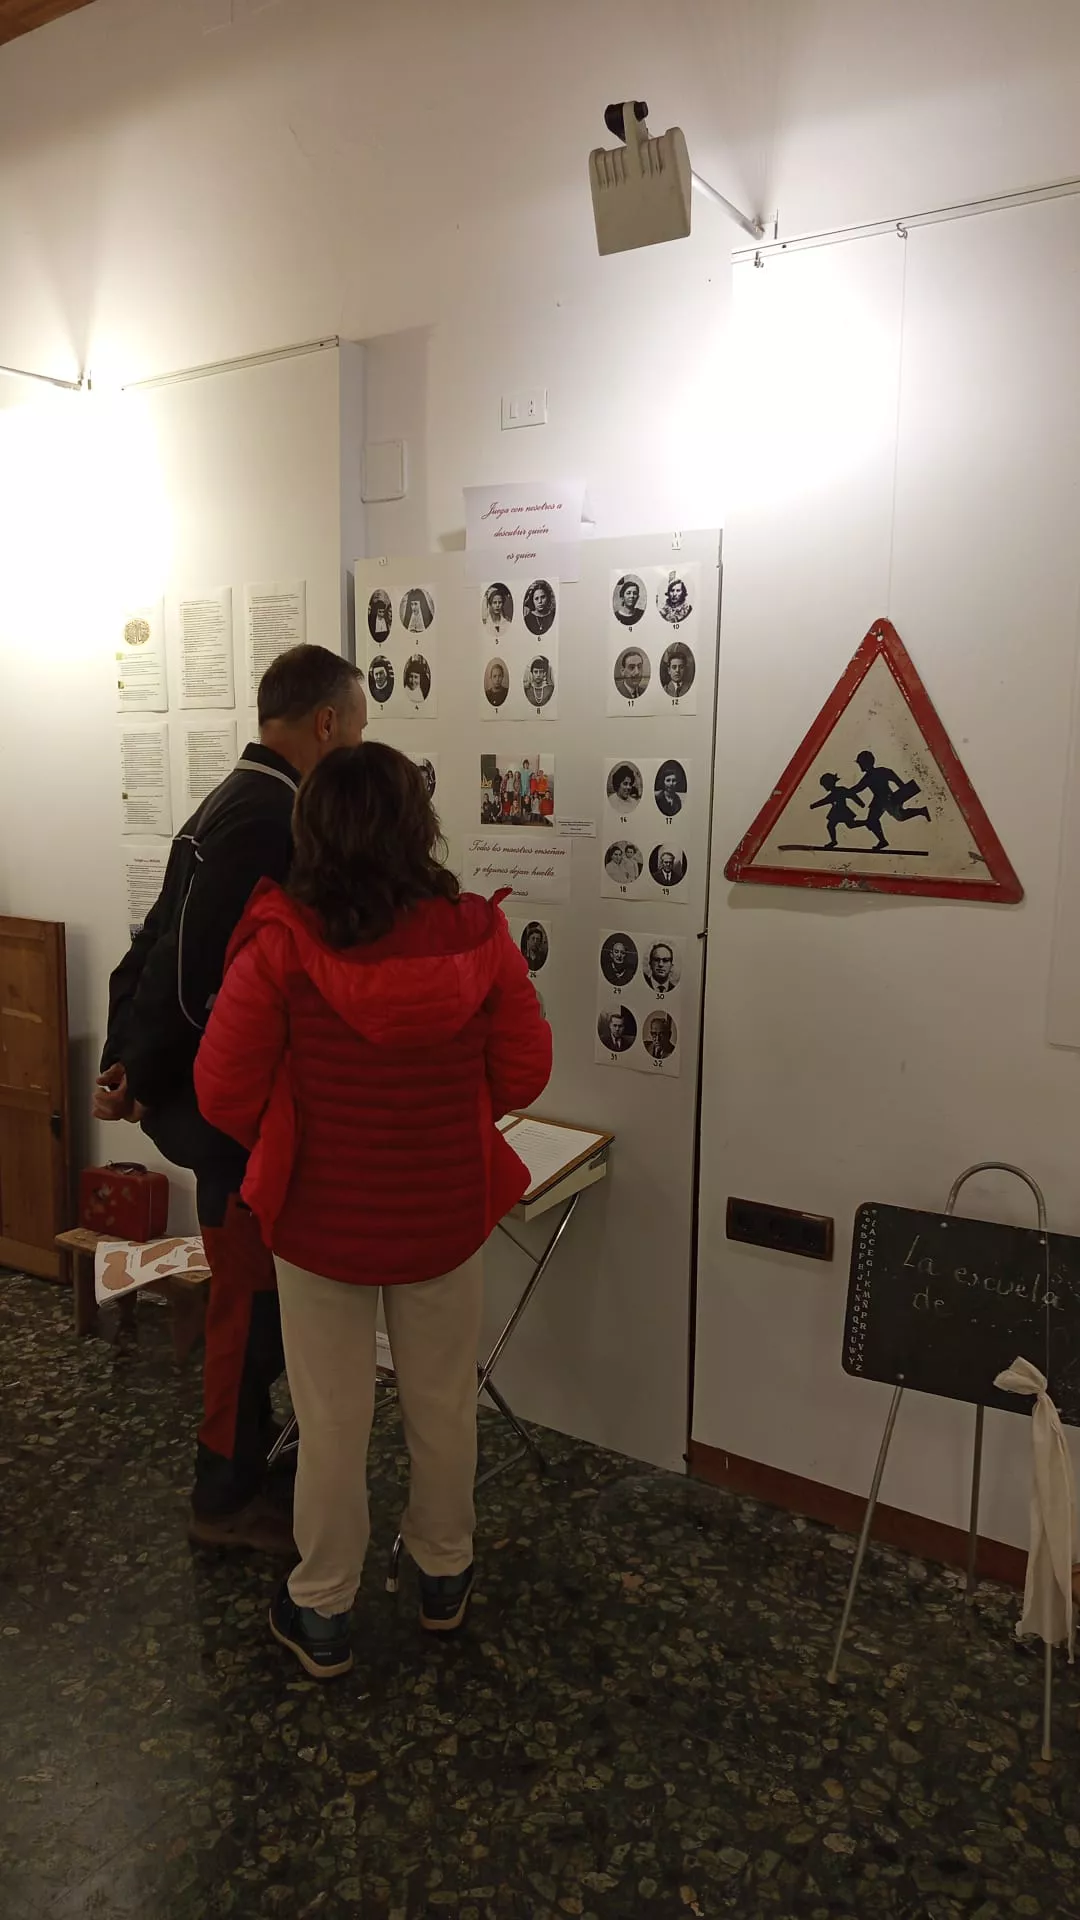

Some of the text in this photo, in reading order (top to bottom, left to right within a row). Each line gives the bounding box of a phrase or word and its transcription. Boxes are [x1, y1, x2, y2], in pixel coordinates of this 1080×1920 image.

[481, 502, 509, 519] Juega
[525, 501, 555, 512] nosotros
[494, 525, 549, 539] descubrir quién
[469, 840, 565, 855] Todos los maestros enseñan
[473, 864, 554, 879] y algunos dejan huella
[904, 1234, 1064, 1311] La escuela
[912, 1286, 945, 1311] de
